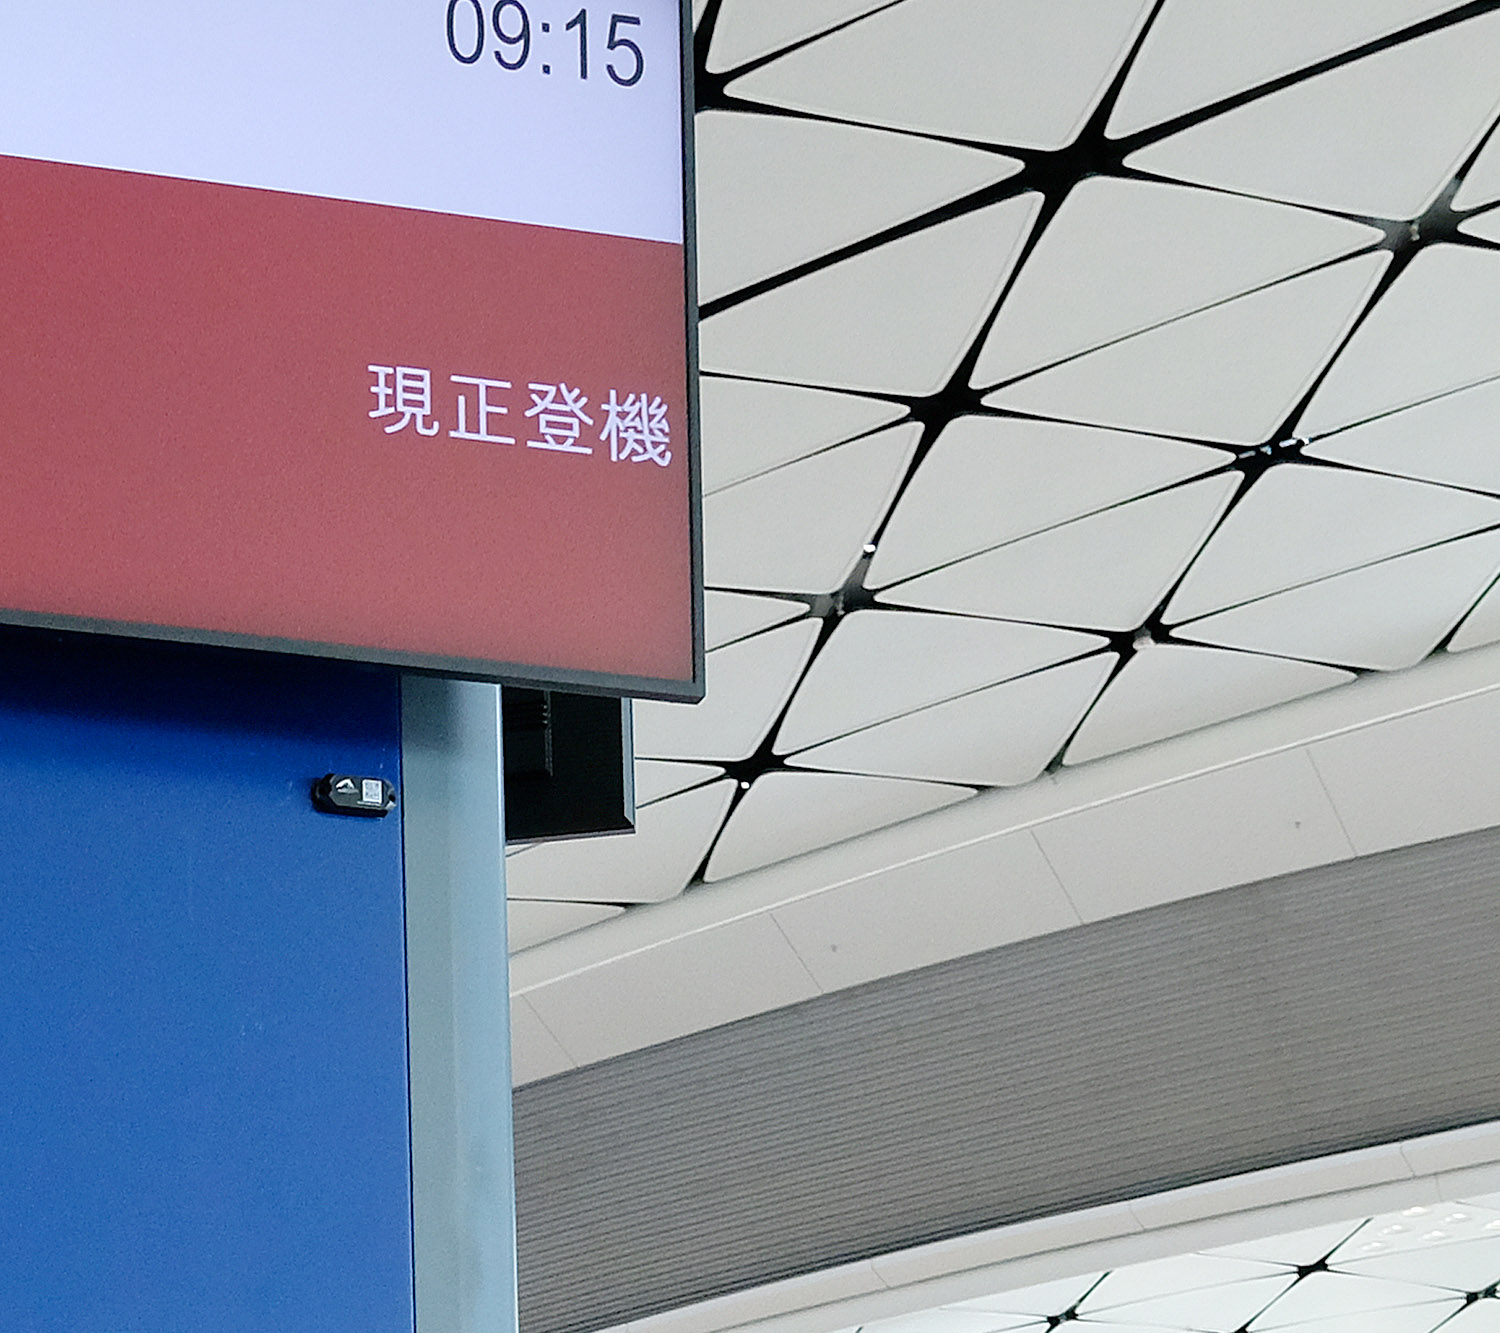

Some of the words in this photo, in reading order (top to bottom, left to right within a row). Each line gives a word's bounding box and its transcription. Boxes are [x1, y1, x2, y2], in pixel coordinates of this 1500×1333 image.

[446, 0, 645, 87] 09:15
[366, 363, 673, 468] 現正登機
